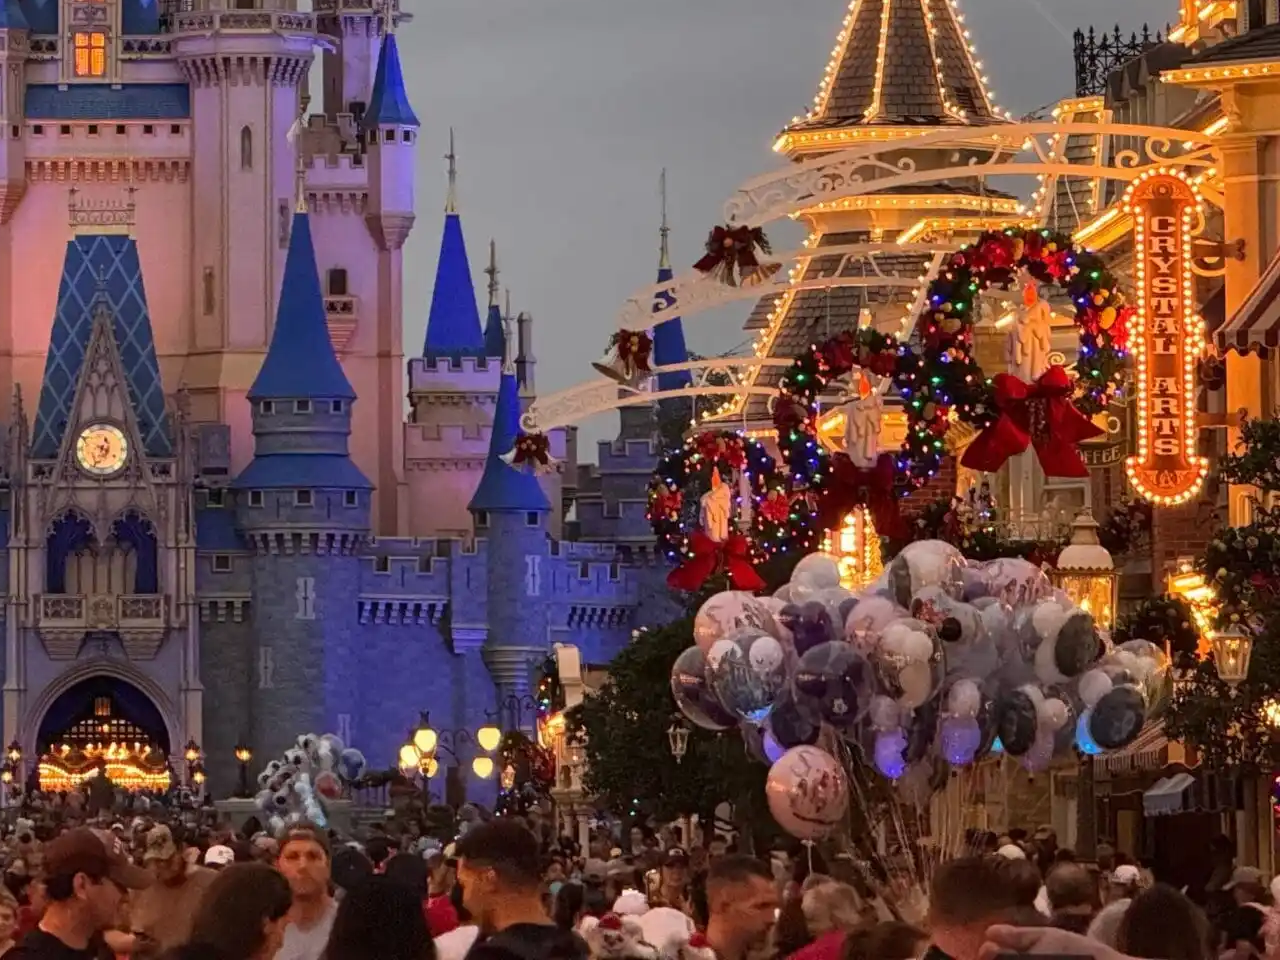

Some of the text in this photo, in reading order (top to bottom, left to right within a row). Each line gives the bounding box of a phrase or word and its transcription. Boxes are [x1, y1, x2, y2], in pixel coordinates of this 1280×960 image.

[1150, 216, 1178, 355] CRYSTAL
[1075, 444, 1121, 464] OFFEE
[1151, 376, 1180, 456] ARTS
